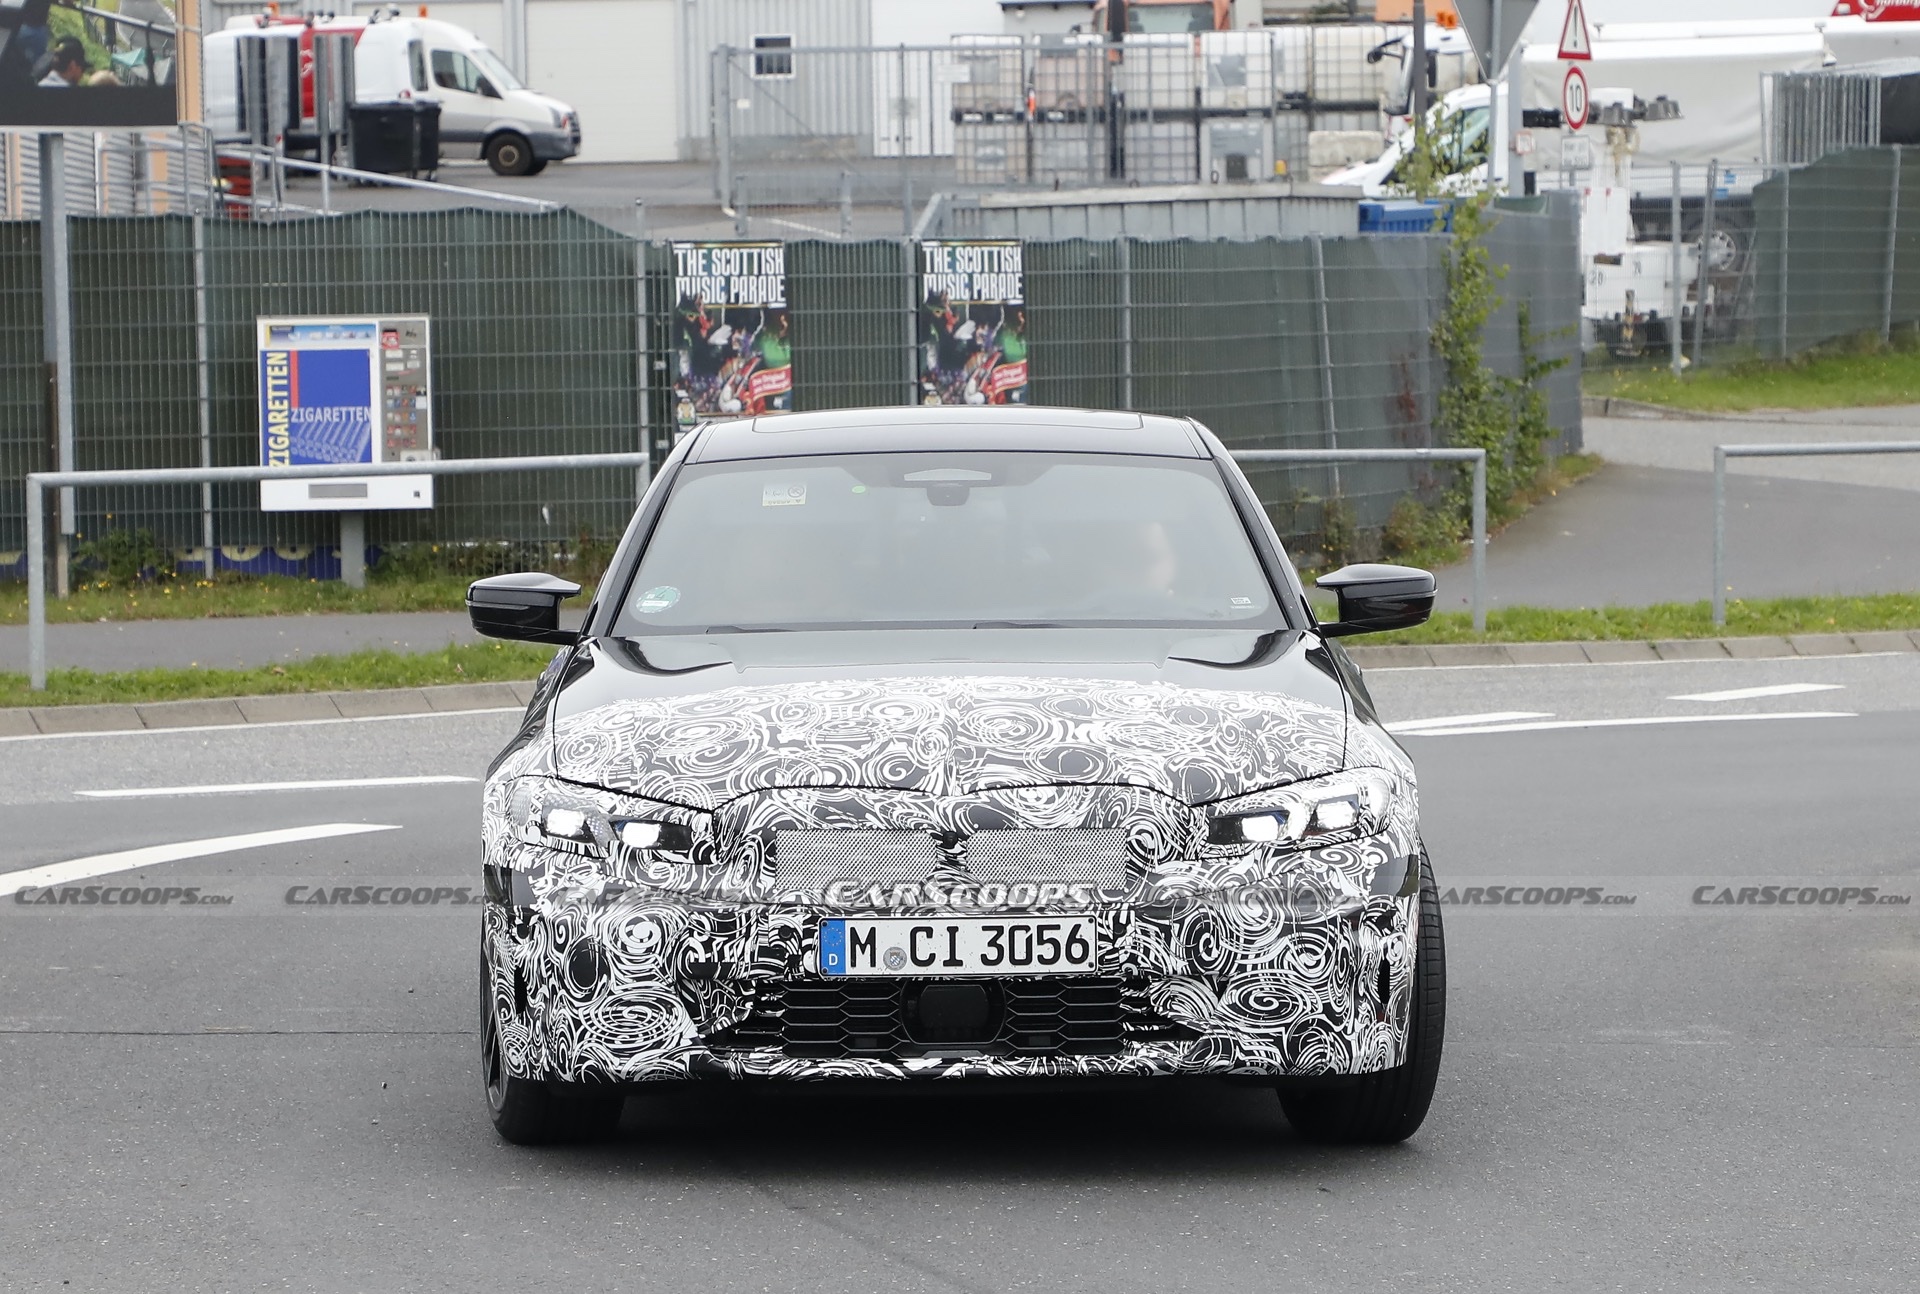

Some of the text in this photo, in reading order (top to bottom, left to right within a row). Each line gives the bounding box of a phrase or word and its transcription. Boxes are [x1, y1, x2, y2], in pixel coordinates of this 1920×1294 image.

[1569, 84, 1582, 112] 10
[673, 248, 785, 276] THE SCOTTISH
[922, 246, 1022, 273] THE SCOTTISH
[675, 275, 786, 308] MUSIC PARADE
[923, 273, 1024, 304] MUSIC PARADE
[267, 352, 290, 467] ZIGARETTEN
[290, 406, 371, 423] ZIGARETTEN
[828, 953, 838, 966] D
[850, 923, 1090, 968] M CI 3056
